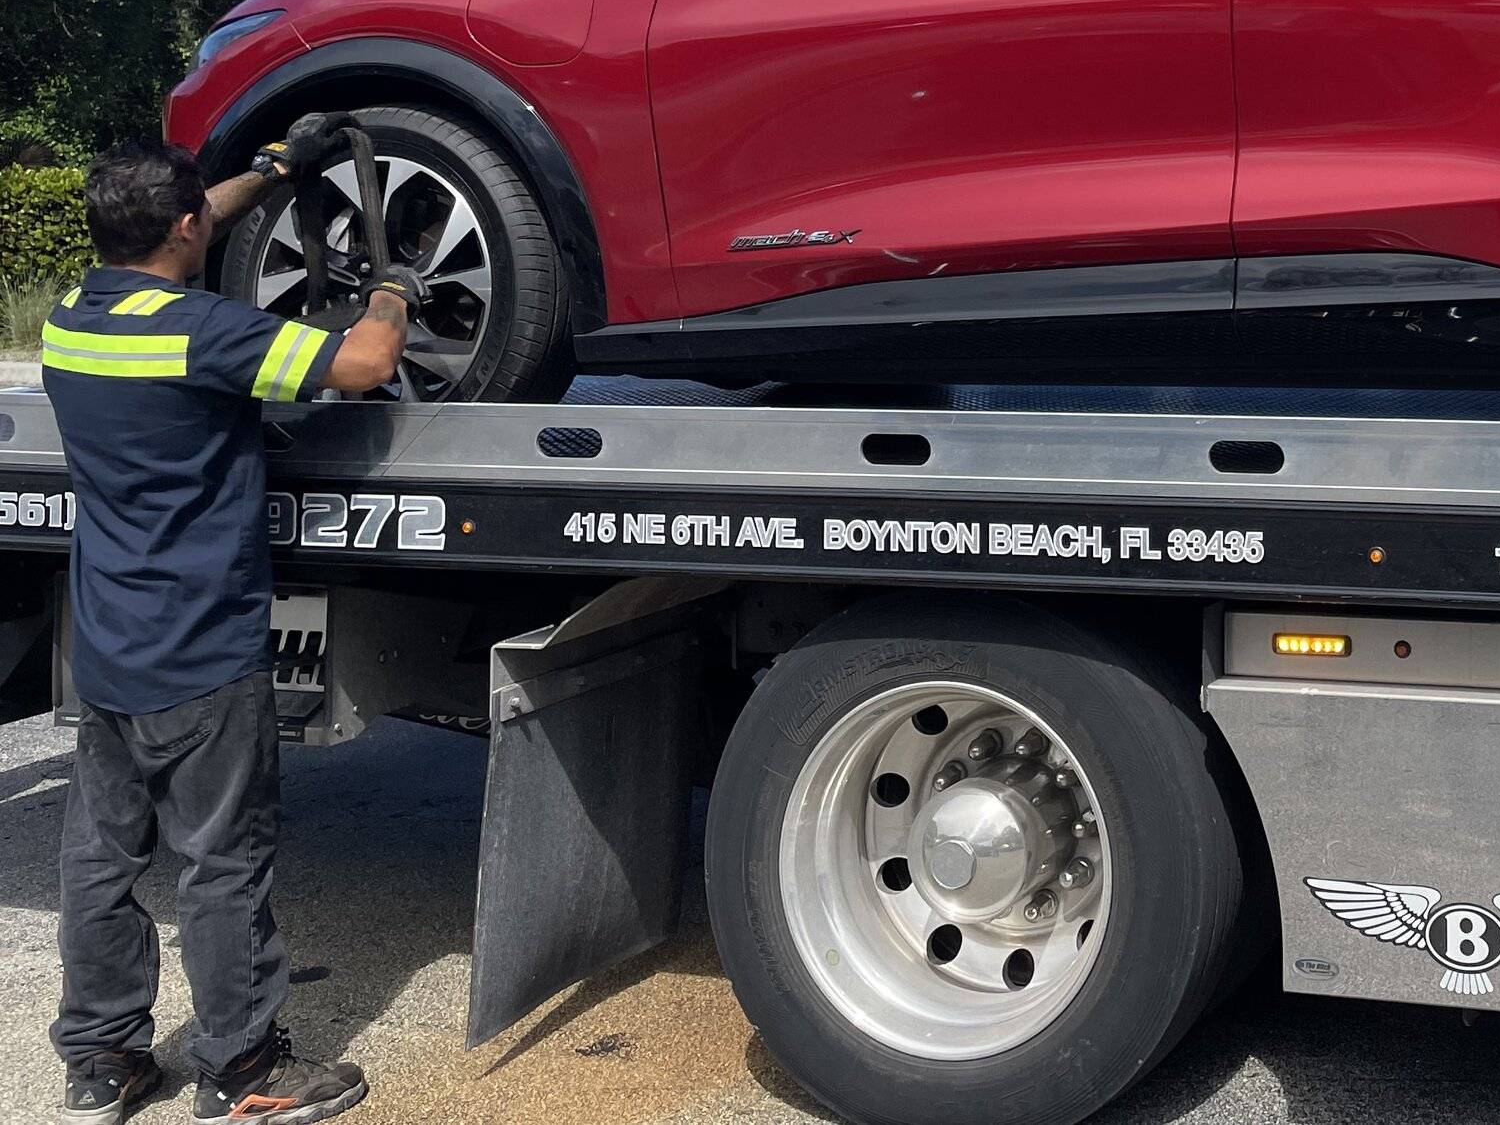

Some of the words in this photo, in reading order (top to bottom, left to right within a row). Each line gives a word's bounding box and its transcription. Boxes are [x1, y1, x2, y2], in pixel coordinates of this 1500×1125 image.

[563, 512, 617, 544] 415
[622, 513, 666, 545] NE
[671, 515, 730, 547] 6TH
[734, 517, 805, 549] AVE.
[823, 518, 981, 555] BOYNTON
[988, 523, 1112, 565] BEACH,
[1119, 527, 1162, 560] FL
[1166, 528, 1265, 564] 33435
[1445, 910, 1489, 964] B
